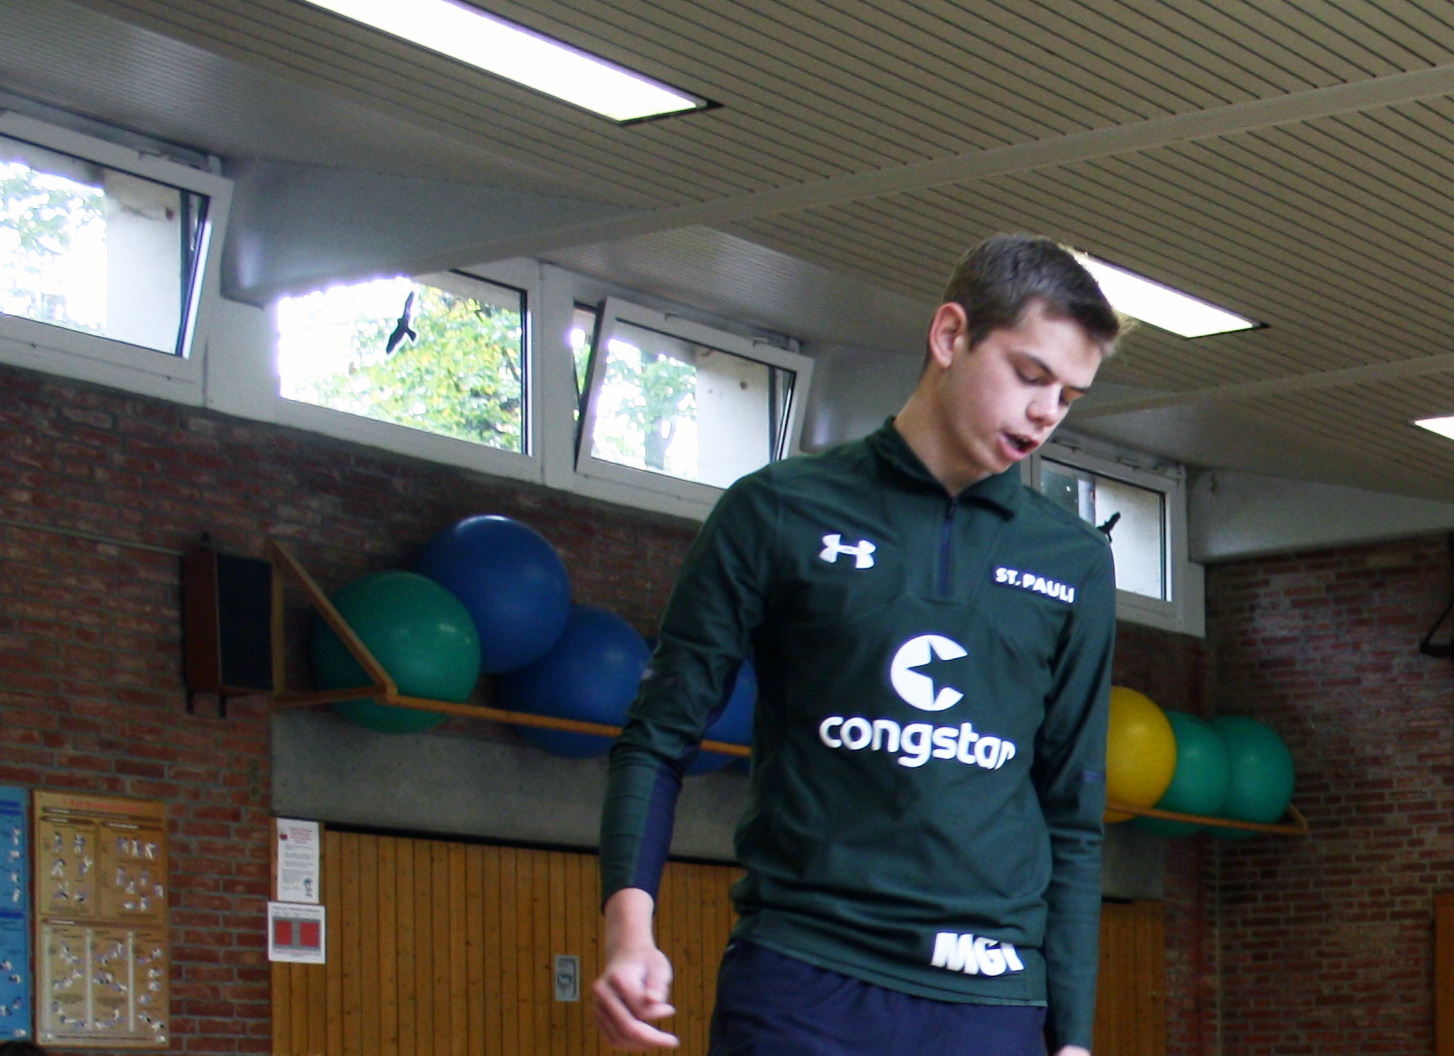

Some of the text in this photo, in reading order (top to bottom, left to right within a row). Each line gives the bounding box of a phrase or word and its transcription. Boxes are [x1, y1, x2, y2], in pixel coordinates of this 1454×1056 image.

[995, 567, 1075, 604] ST. PAULI
[819, 716, 1016, 771] congstar
[930, 932, 1024, 976] MGI
